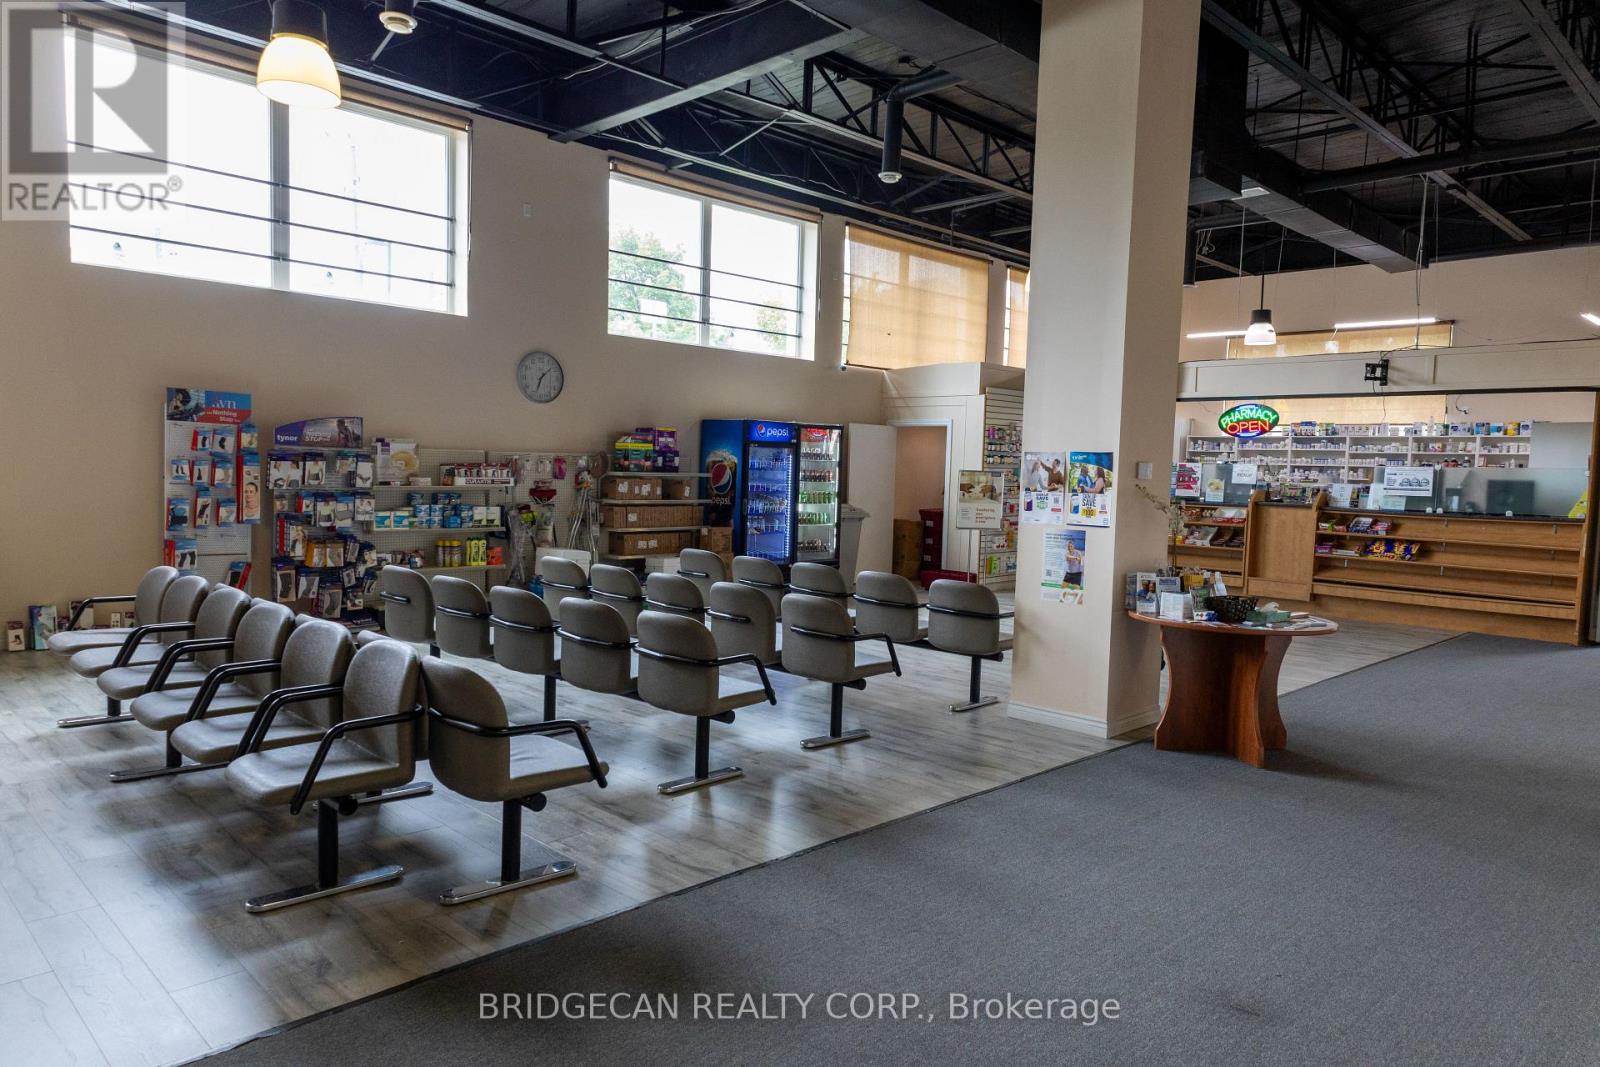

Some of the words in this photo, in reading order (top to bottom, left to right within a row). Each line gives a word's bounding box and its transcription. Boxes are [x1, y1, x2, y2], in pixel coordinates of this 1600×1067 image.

[1220, 408, 1277, 429] PHARMACY
[766, 427, 789, 437] pepsi
[1226, 420, 1269, 434] OPEN
[277, 434, 298, 442] tynor
